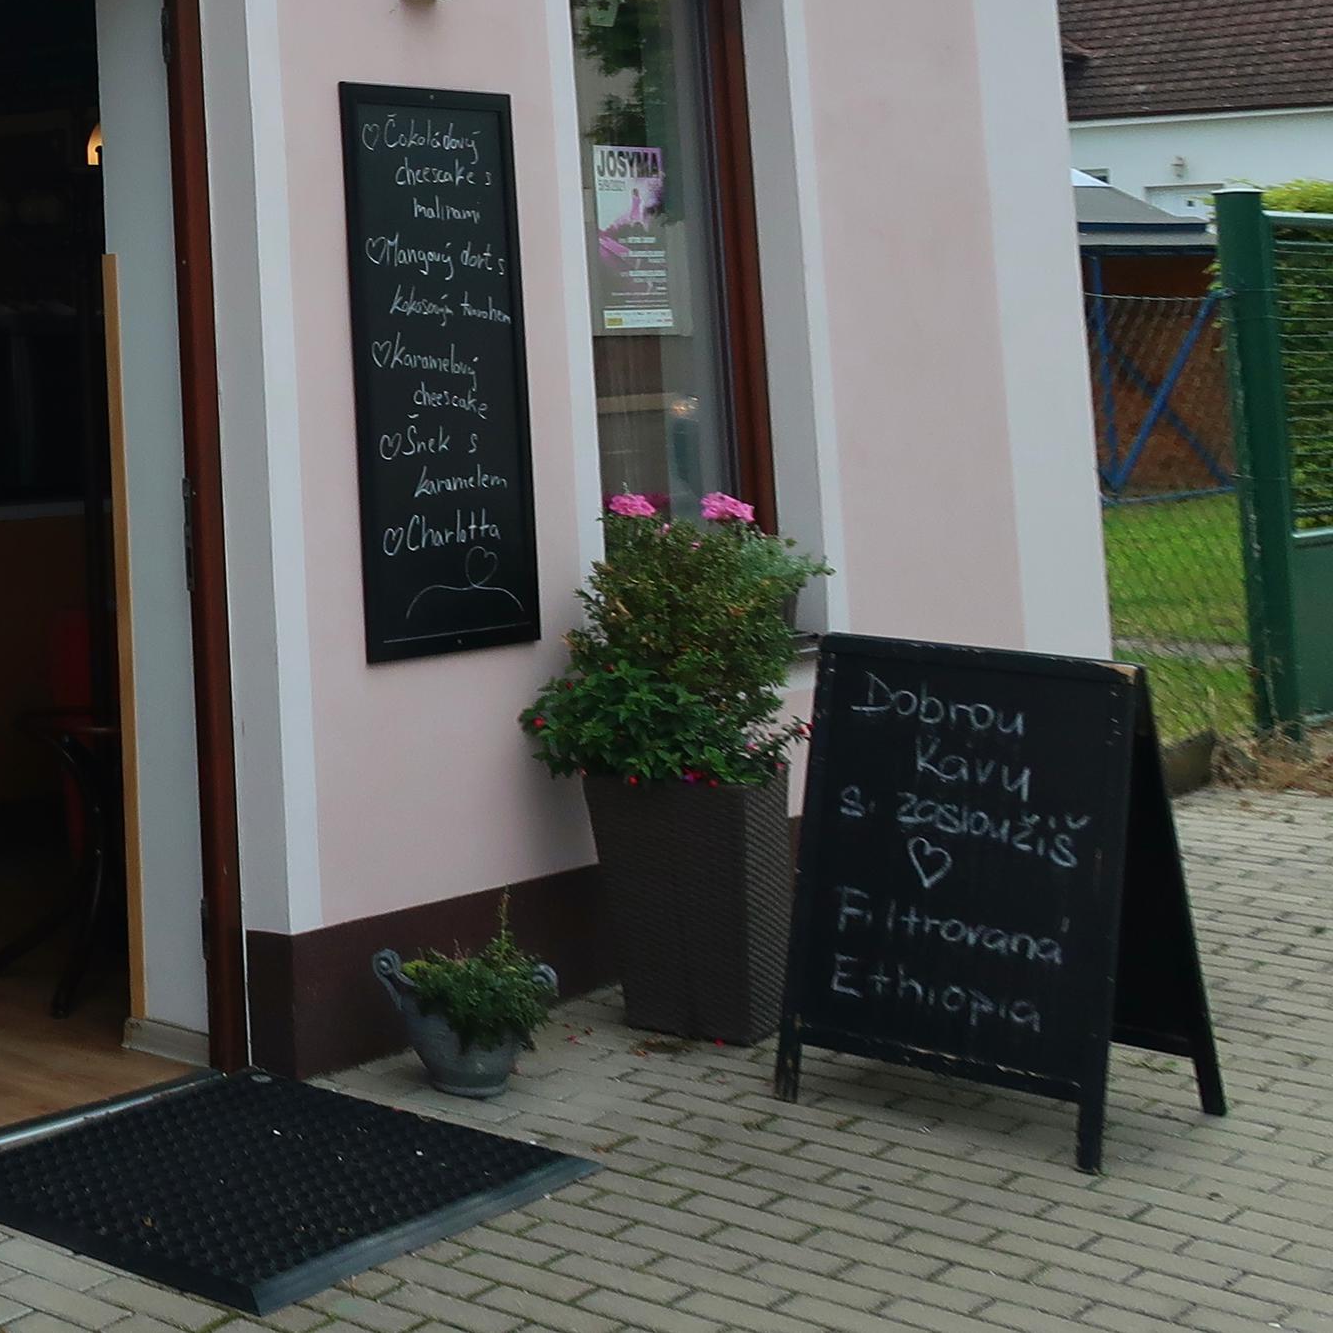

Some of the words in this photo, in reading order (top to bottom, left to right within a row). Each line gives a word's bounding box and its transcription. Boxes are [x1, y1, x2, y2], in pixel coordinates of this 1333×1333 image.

[597, 150, 660, 178] JOSYMA
[407, 508, 501, 551] Charlotta
[851, 671, 1025, 736] Dobrou
[830, 952, 1041, 1033] Ethiopia
